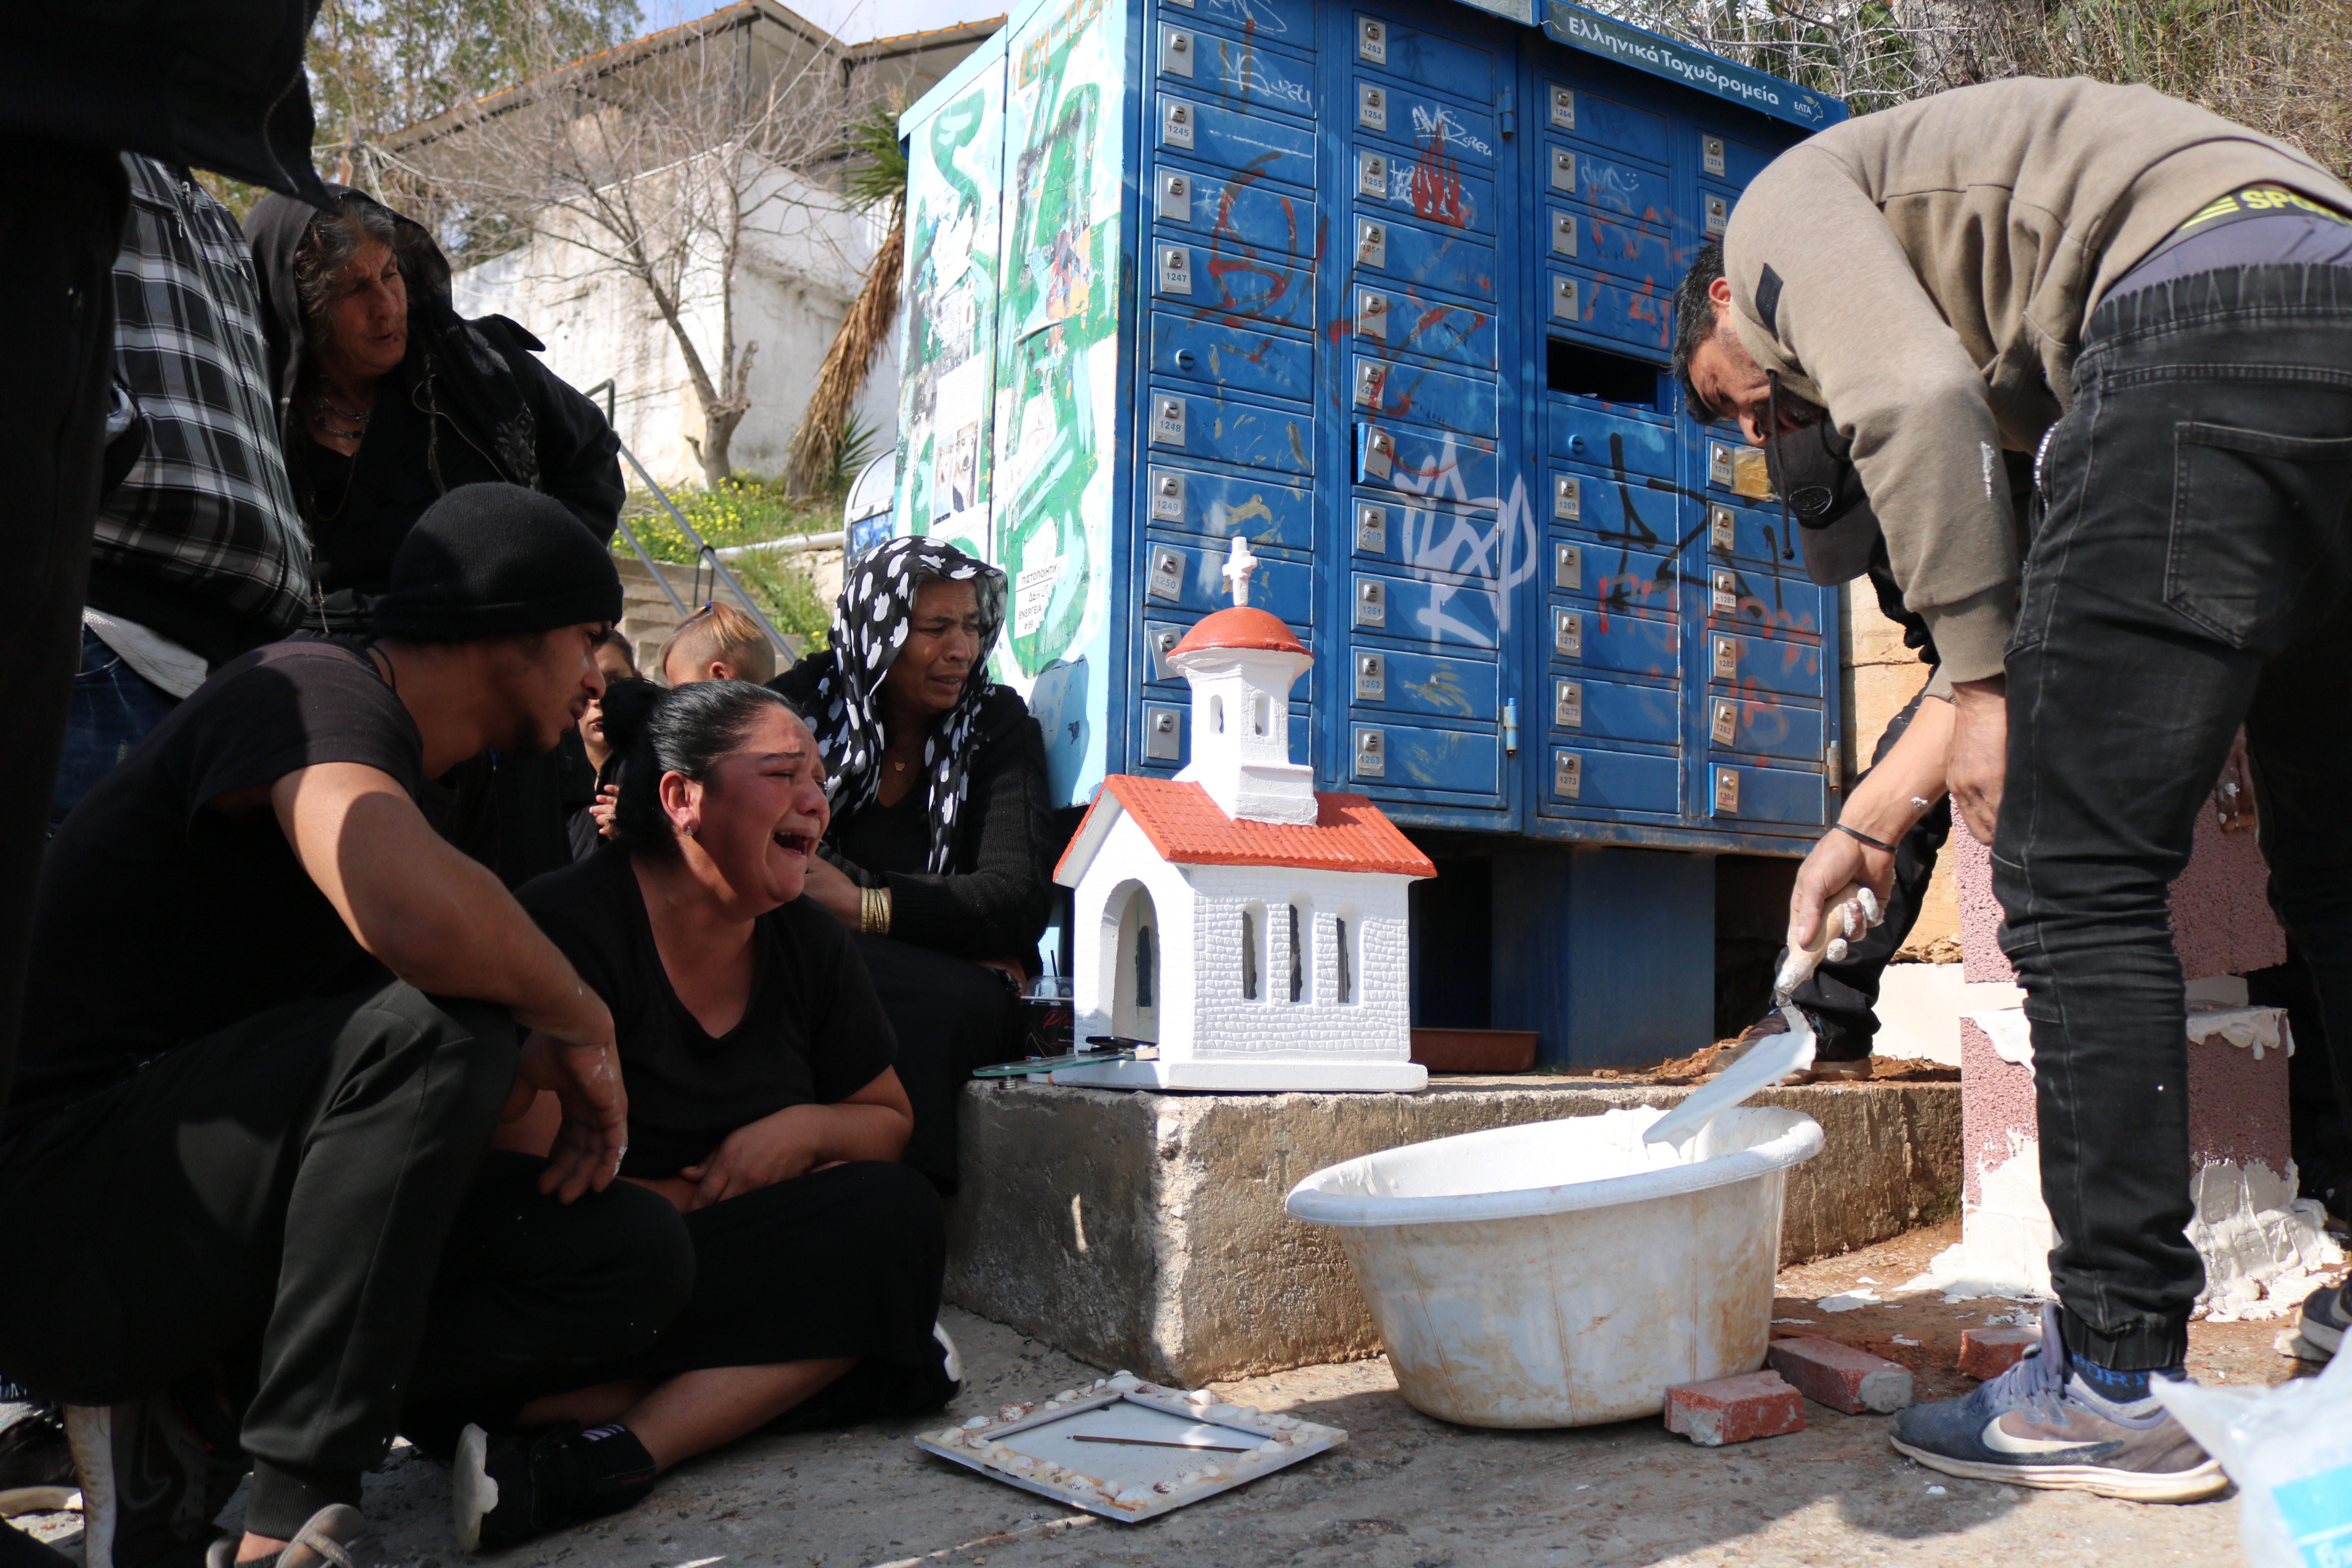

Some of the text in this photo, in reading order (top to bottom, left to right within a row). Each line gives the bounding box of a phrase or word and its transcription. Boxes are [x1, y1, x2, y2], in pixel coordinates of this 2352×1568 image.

[1363, 43, 1381, 54] 1253
[1569, 16, 1779, 105] Ελληνικά Ταχυδρομεία
[1555, 108, 1572, 118] 1264
[1794, 101, 1812, 115] ΕΛΤΑ
[1364, 109, 1382, 120] 1254
[1168, 124, 1189, 137] 1245
[1707, 158, 1722, 167] 1274
[1364, 176, 1382, 188] 1255
[1710, 217, 1724, 227] 1275
[1166, 272, 1187, 283] 1247
[1160, 420, 1181, 432] 1248
[1715, 465, 1730, 475] 1279
[1157, 500, 1178, 512] 1249
[1559, 501, 1576, 510] 1269
[1717, 529, 1731, 540] 1280
[1155, 575, 1176, 589] 1250
[1720, 596, 1734, 604] 1281
[1363, 606, 1381, 616] 1261
[1560, 636, 1576, 646] 1271
[1719, 660, 1734, 668] 1282
[1361, 680, 1381, 689] 1262
[1561, 707, 1579, 716] 1272
[1716, 723, 1731, 735] 1283
[1361, 755, 1381, 764] 1263
[1560, 776, 1577, 785] 1273
[1720, 792, 1735, 801] 1284
